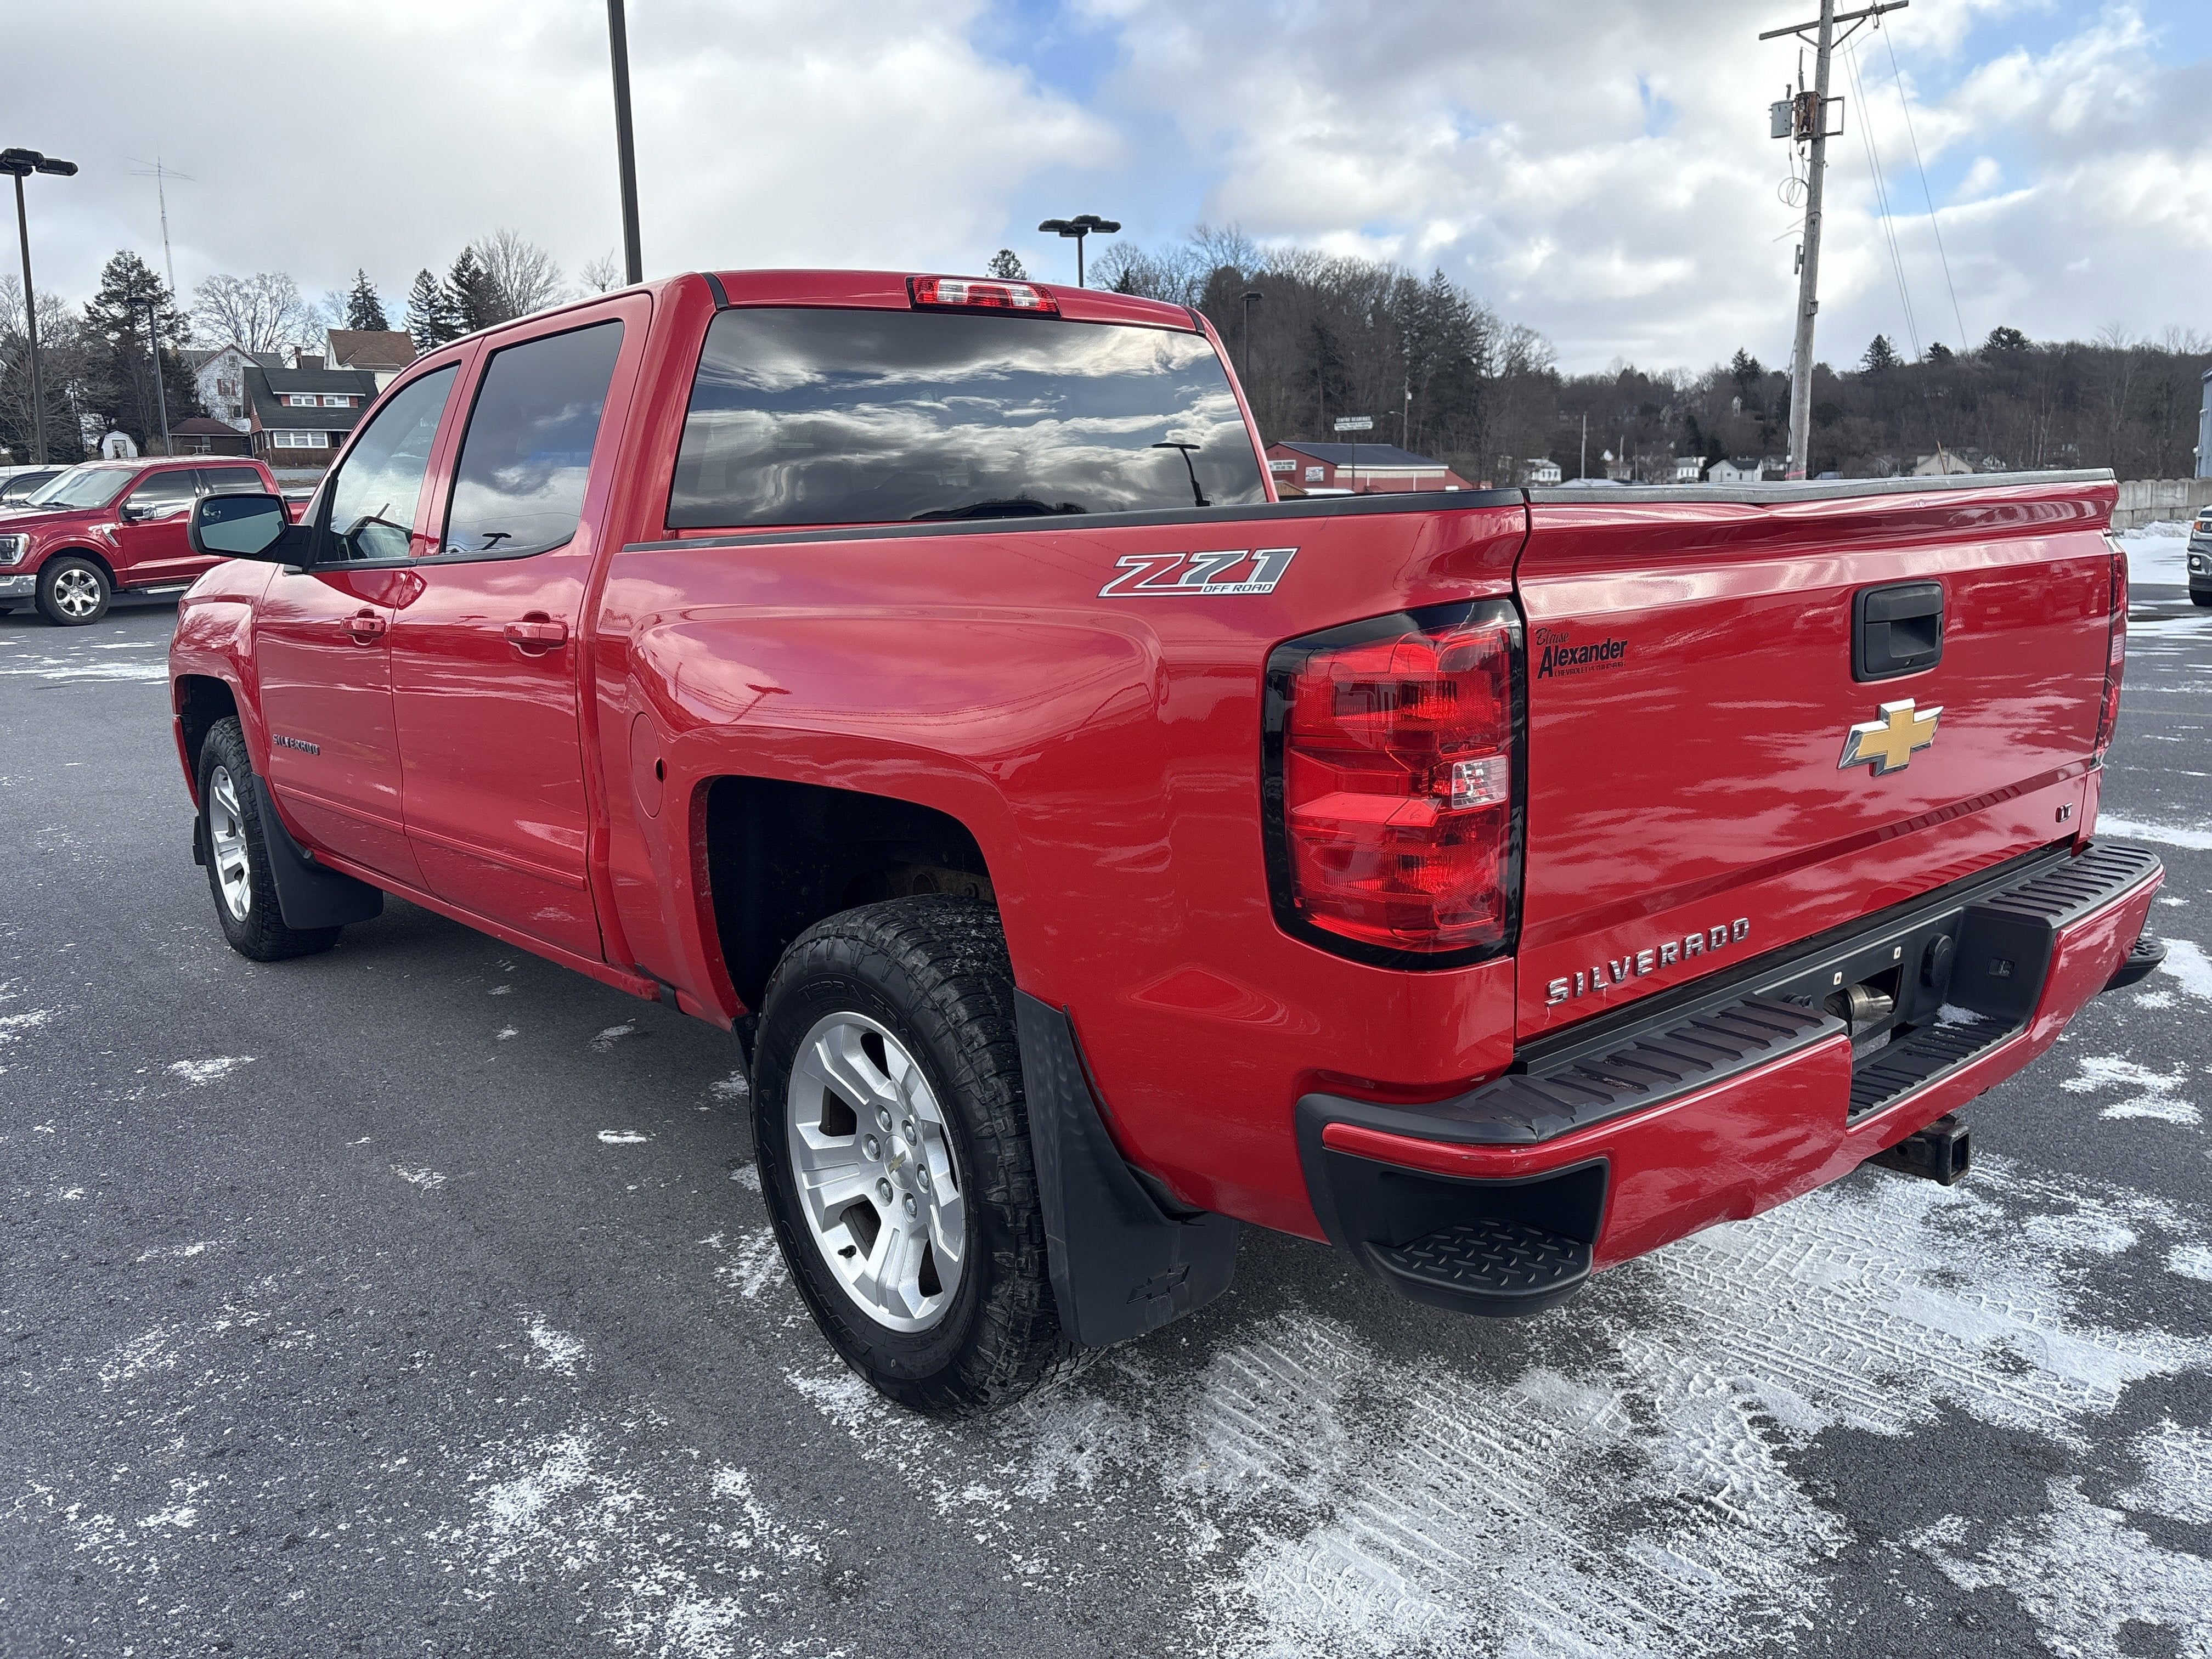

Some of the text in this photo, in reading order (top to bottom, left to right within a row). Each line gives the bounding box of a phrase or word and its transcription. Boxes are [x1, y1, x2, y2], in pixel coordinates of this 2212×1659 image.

[1096, 546, 1301, 598] Z71
[1232, 584, 1272, 592] ROAD
[1538, 637, 1628, 679] Alexander
[1544, 917, 1750, 1007] SILVERADO
